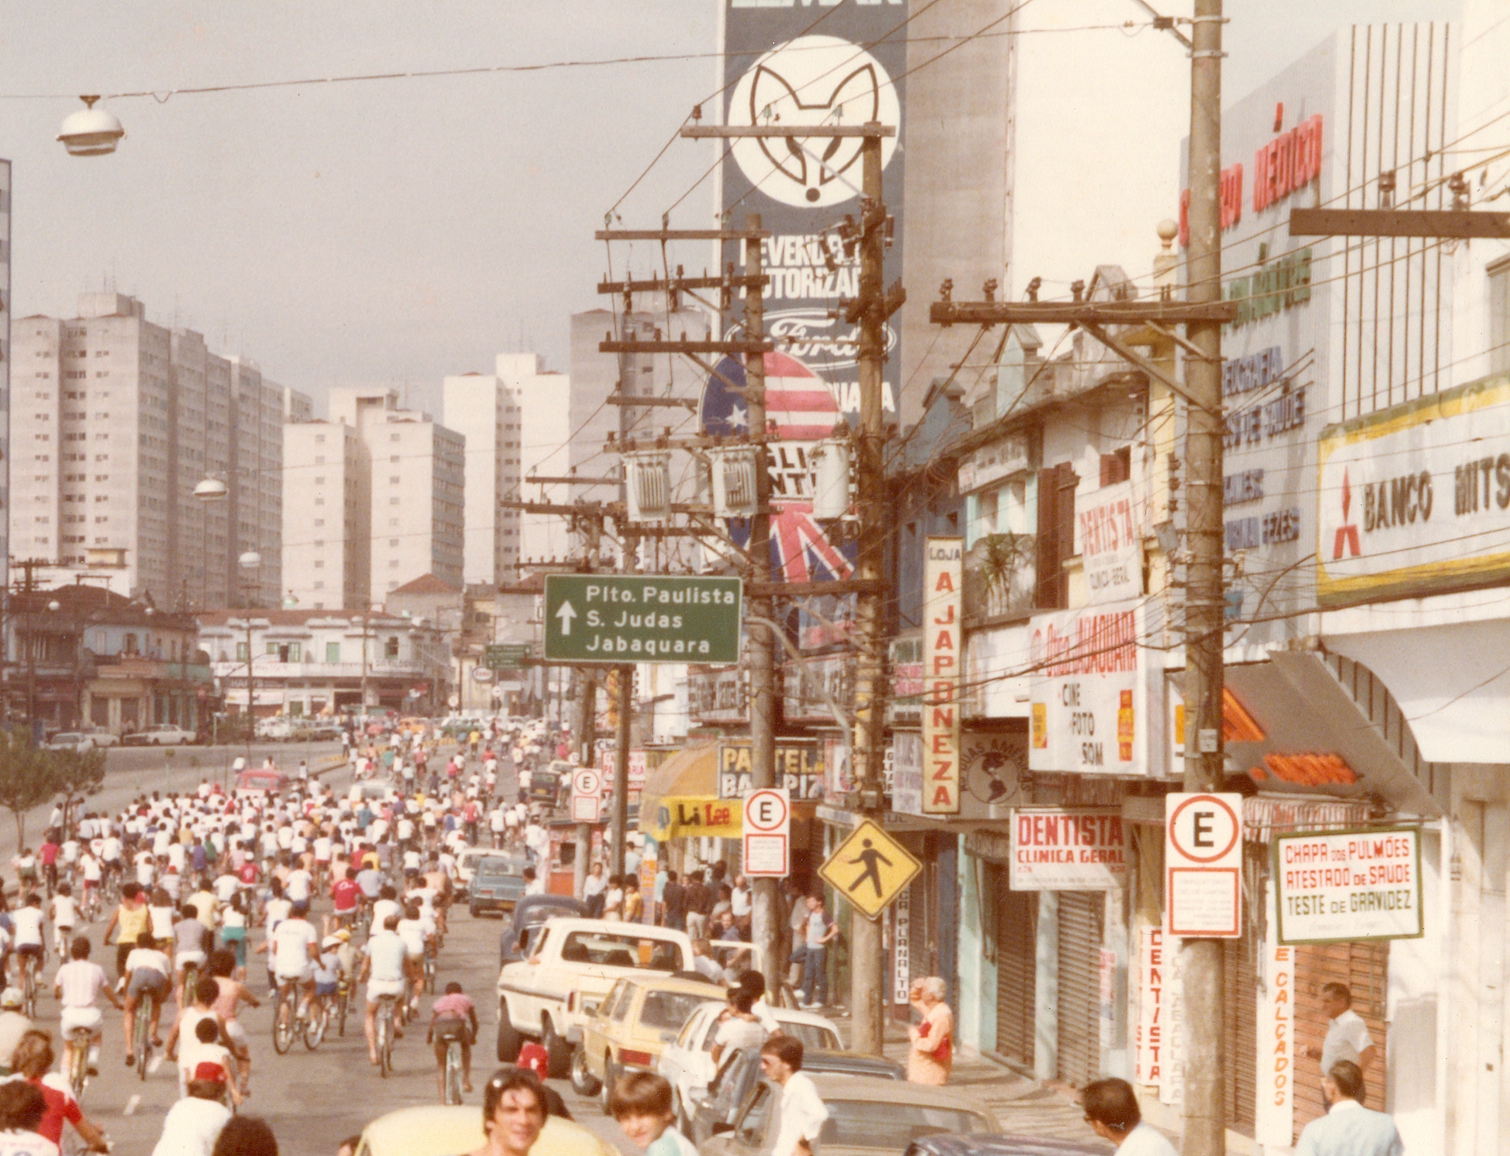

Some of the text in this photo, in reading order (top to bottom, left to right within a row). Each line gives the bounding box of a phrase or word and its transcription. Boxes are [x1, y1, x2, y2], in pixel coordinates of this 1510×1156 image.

[1363, 469, 1434, 533] BANCO
[929, 549, 960, 560] LOJA
[935, 572, 954, 592] A
[586, 586, 735, 604] Plto. Paulista
[586, 610, 683, 628] S. Judas
[586, 636, 710, 654] Jabaquara
[933, 605, 955, 806] JAPONEZA
[1062, 683, 1081, 707] CINE
[1072, 711, 1095, 736] FOTO
[1082, 741, 1104, 766] SOM
[582, 777, 591, 789] E
[705, 803, 731, 826] Lee
[759, 801, 772, 822] E
[1018, 815, 1125, 846] DENTISTA
[1194, 812, 1215, 847] E
[1017, 849, 1126, 864] CLINICA GERAL
[1286, 843, 1328, 864] CHAPA
[1348, 836, 1410, 860] PULMÕES
[1286, 868, 1350, 890] ATESTADO
[1354, 874, 1366, 886] DE
[1287, 889, 1412, 916] TESTE DE GRAVIDEZ
[1274, 972, 1290, 1107] CALÇADOS
